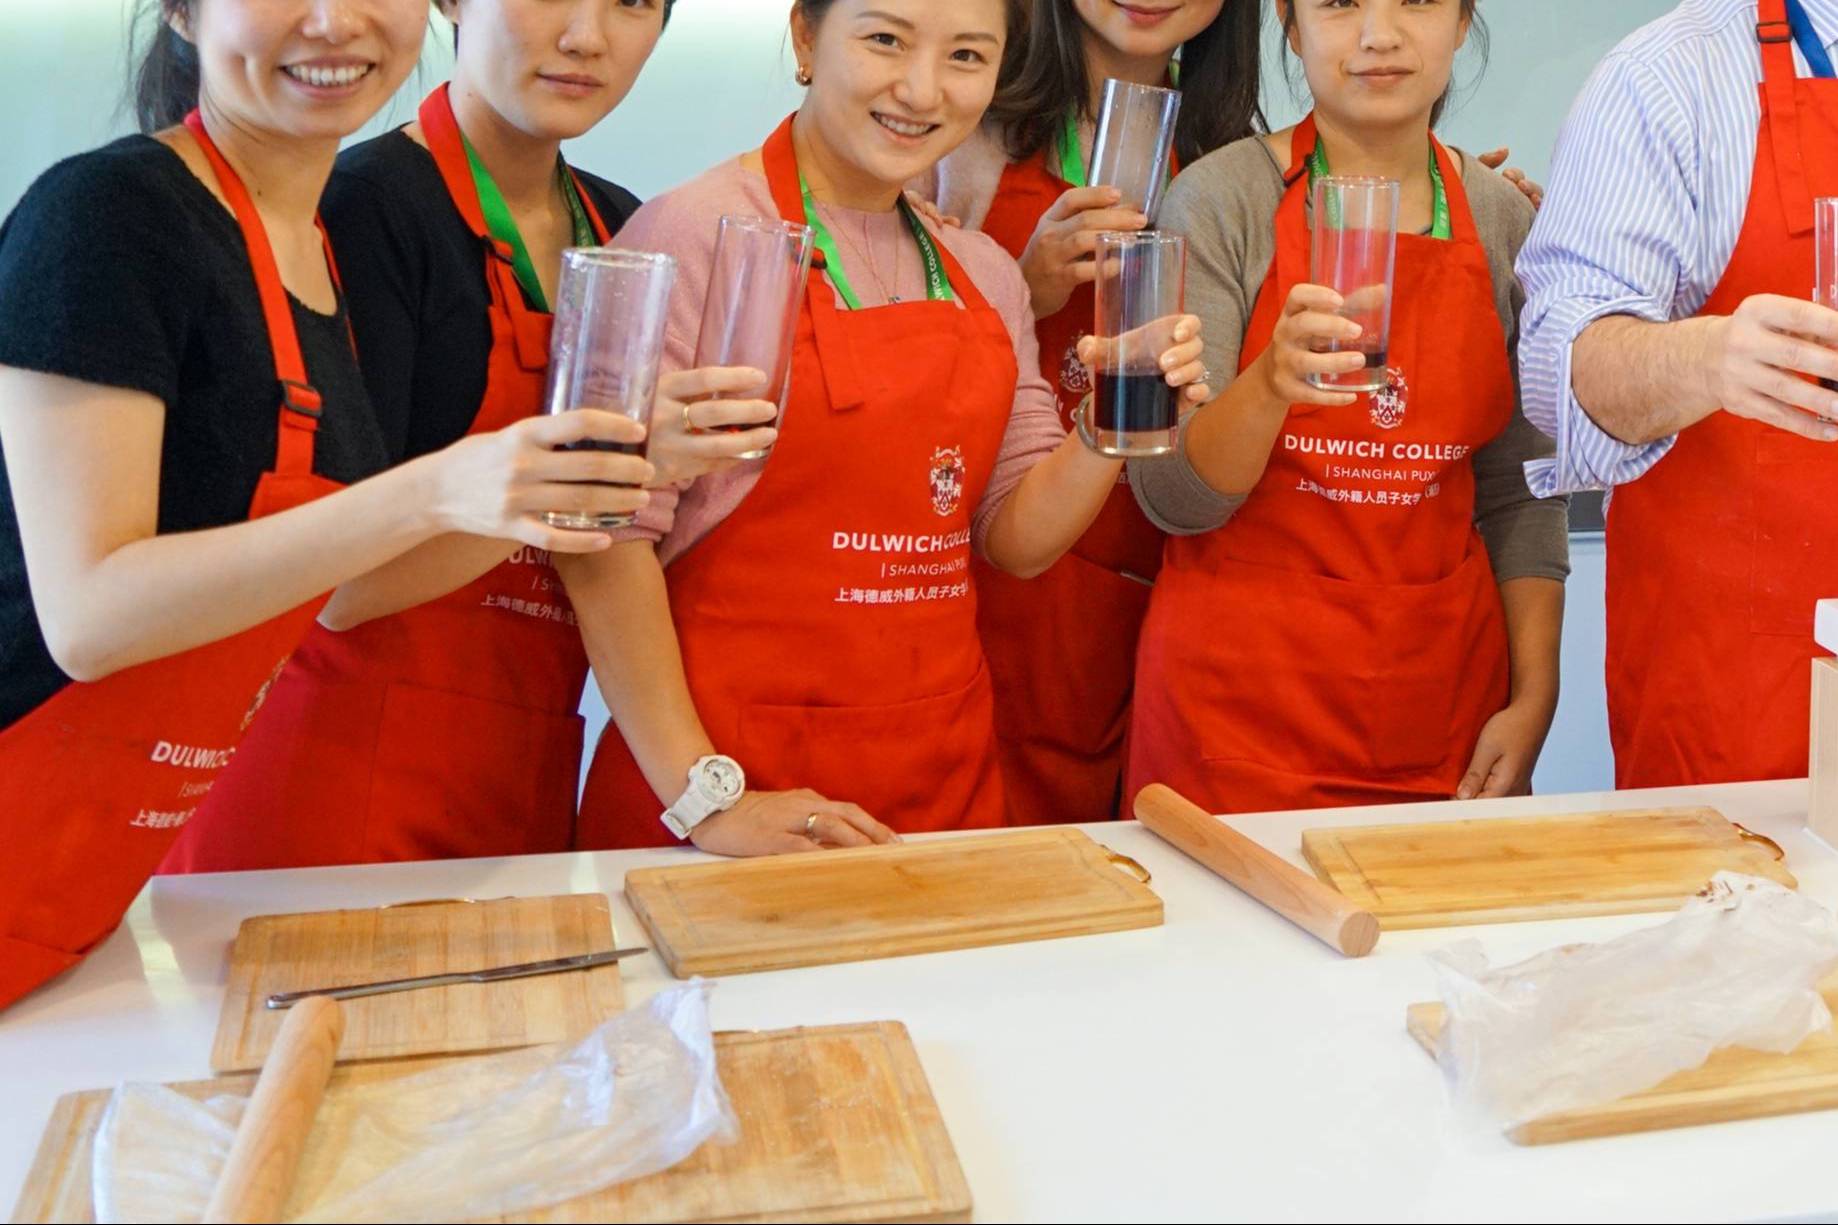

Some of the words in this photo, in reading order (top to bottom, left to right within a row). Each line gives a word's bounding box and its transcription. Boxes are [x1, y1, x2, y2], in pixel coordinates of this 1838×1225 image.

[1284, 434, 1385, 459] DULWICH
[1392, 444, 1470, 461] COLLEGE
[1333, 466, 1407, 480] SHANGHAI
[1411, 470, 1437, 482] PUX
[833, 531, 943, 553] DULWICH
[943, 527, 970, 550] COLL
[889, 561, 956, 577] SHANGHAI
[151, 740, 236, 769] DULWIC
